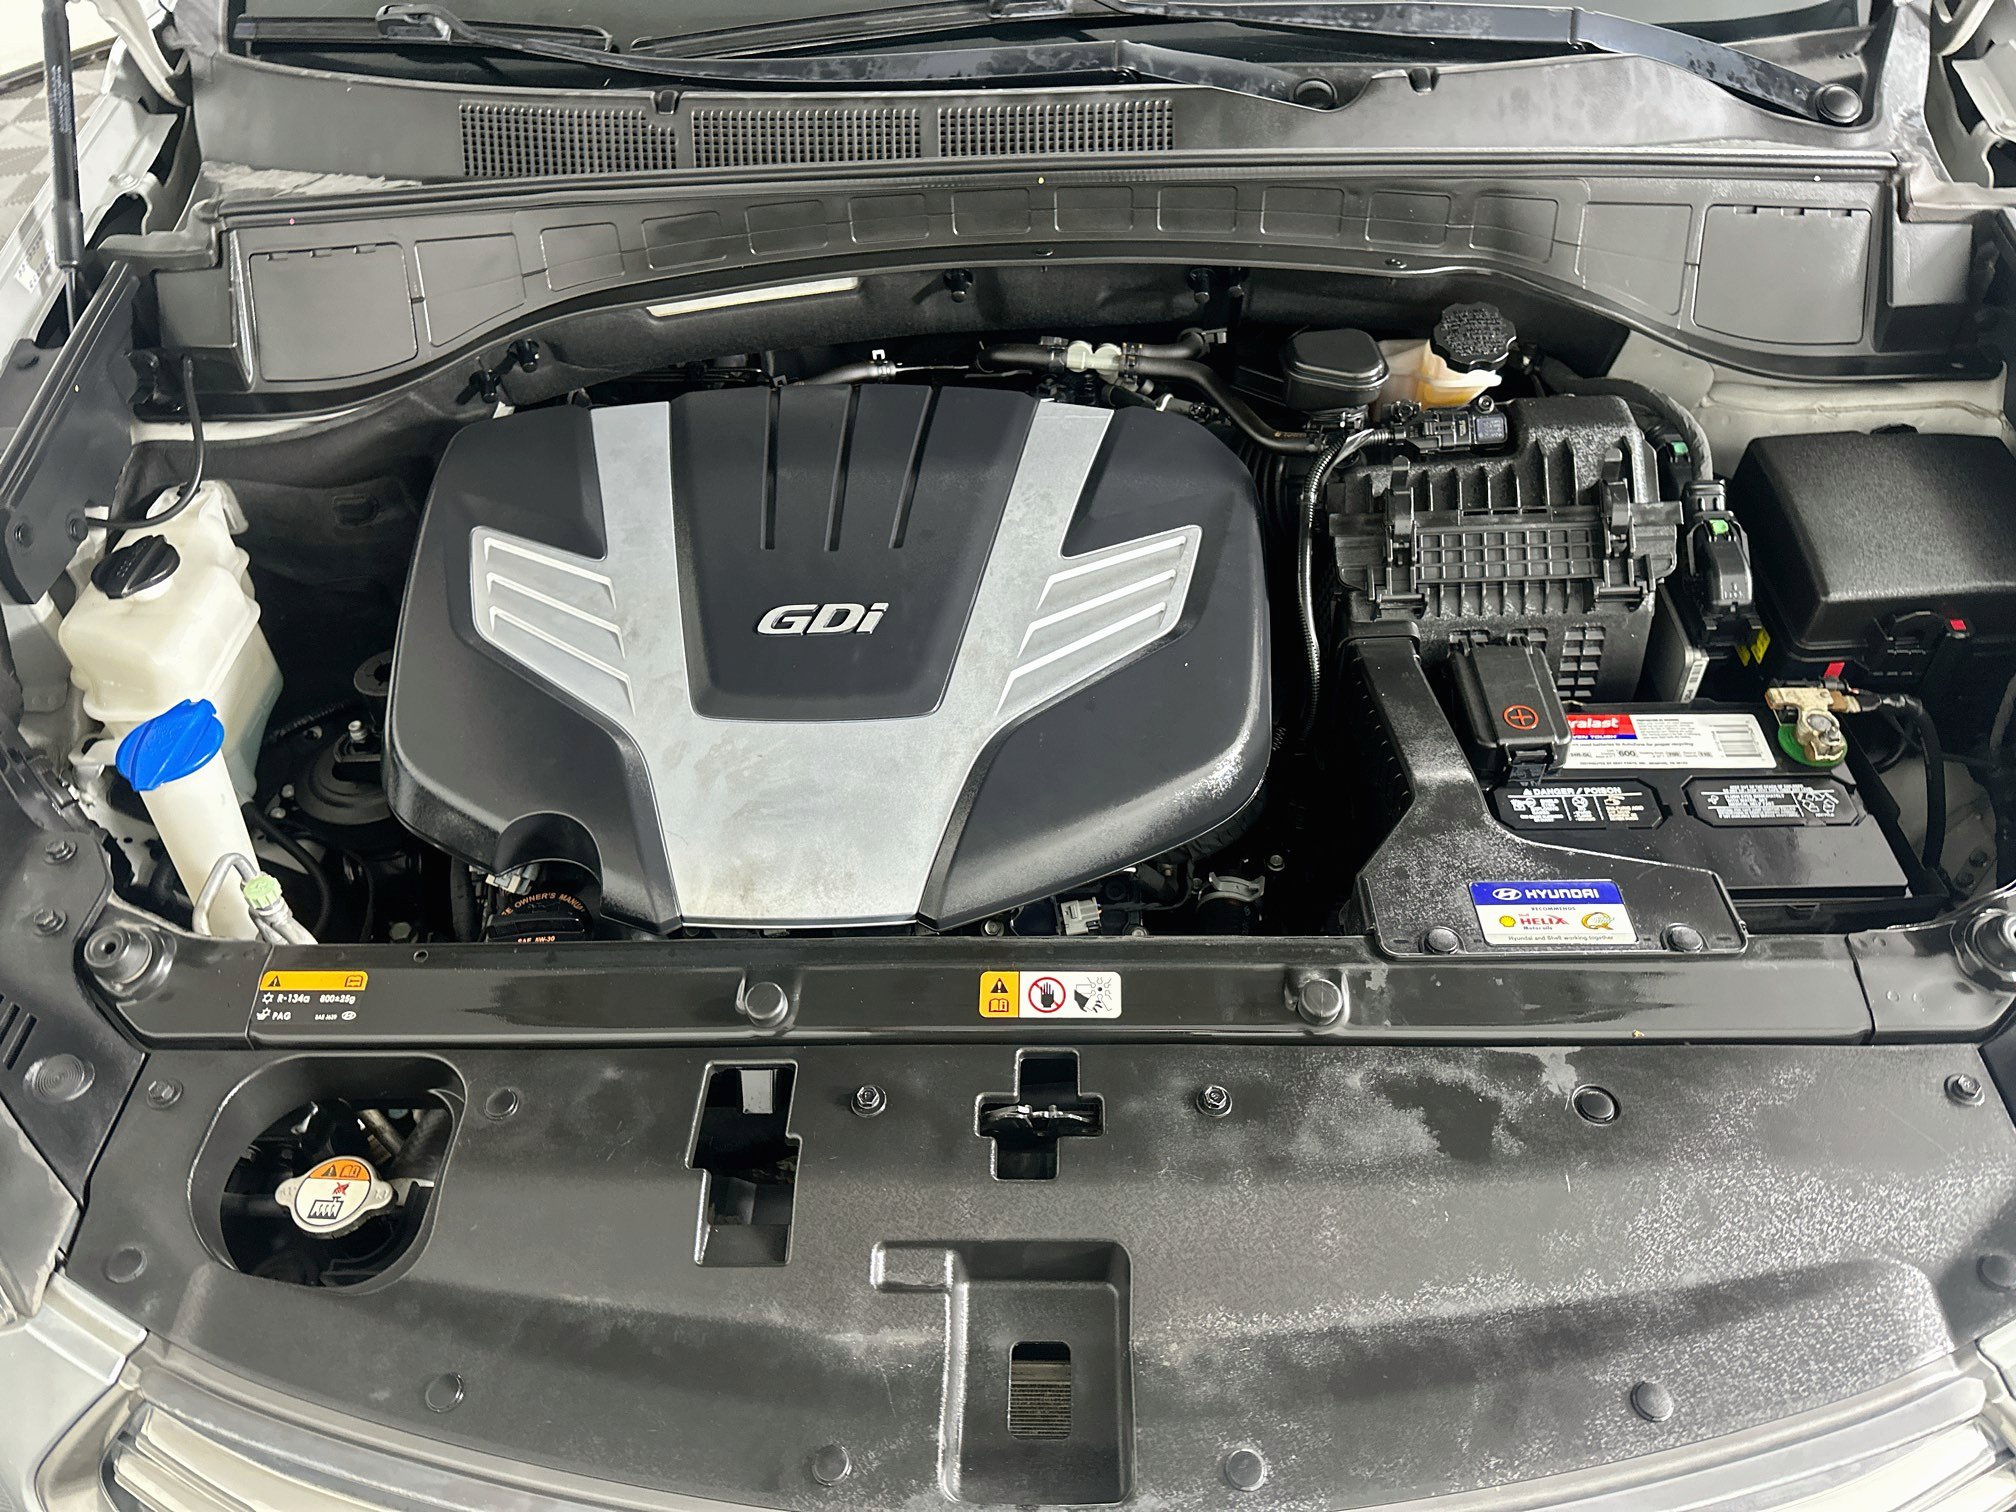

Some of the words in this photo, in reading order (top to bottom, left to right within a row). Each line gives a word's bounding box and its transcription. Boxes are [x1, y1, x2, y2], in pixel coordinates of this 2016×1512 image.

[757, 602, 889, 635] GDi
[1567, 717, 1619, 729] ralast
[1532, 788, 1575, 796] DANGER
[1583, 786, 1622, 795] POISON
[1525, 888, 1600, 899] HYUNDAI
[514, 892, 557, 908] OWNER'S
[1520, 916, 1567, 925] HELIX
[276, 993, 311, 1003] R-134a
[271, 1011, 292, 1020] PAG
